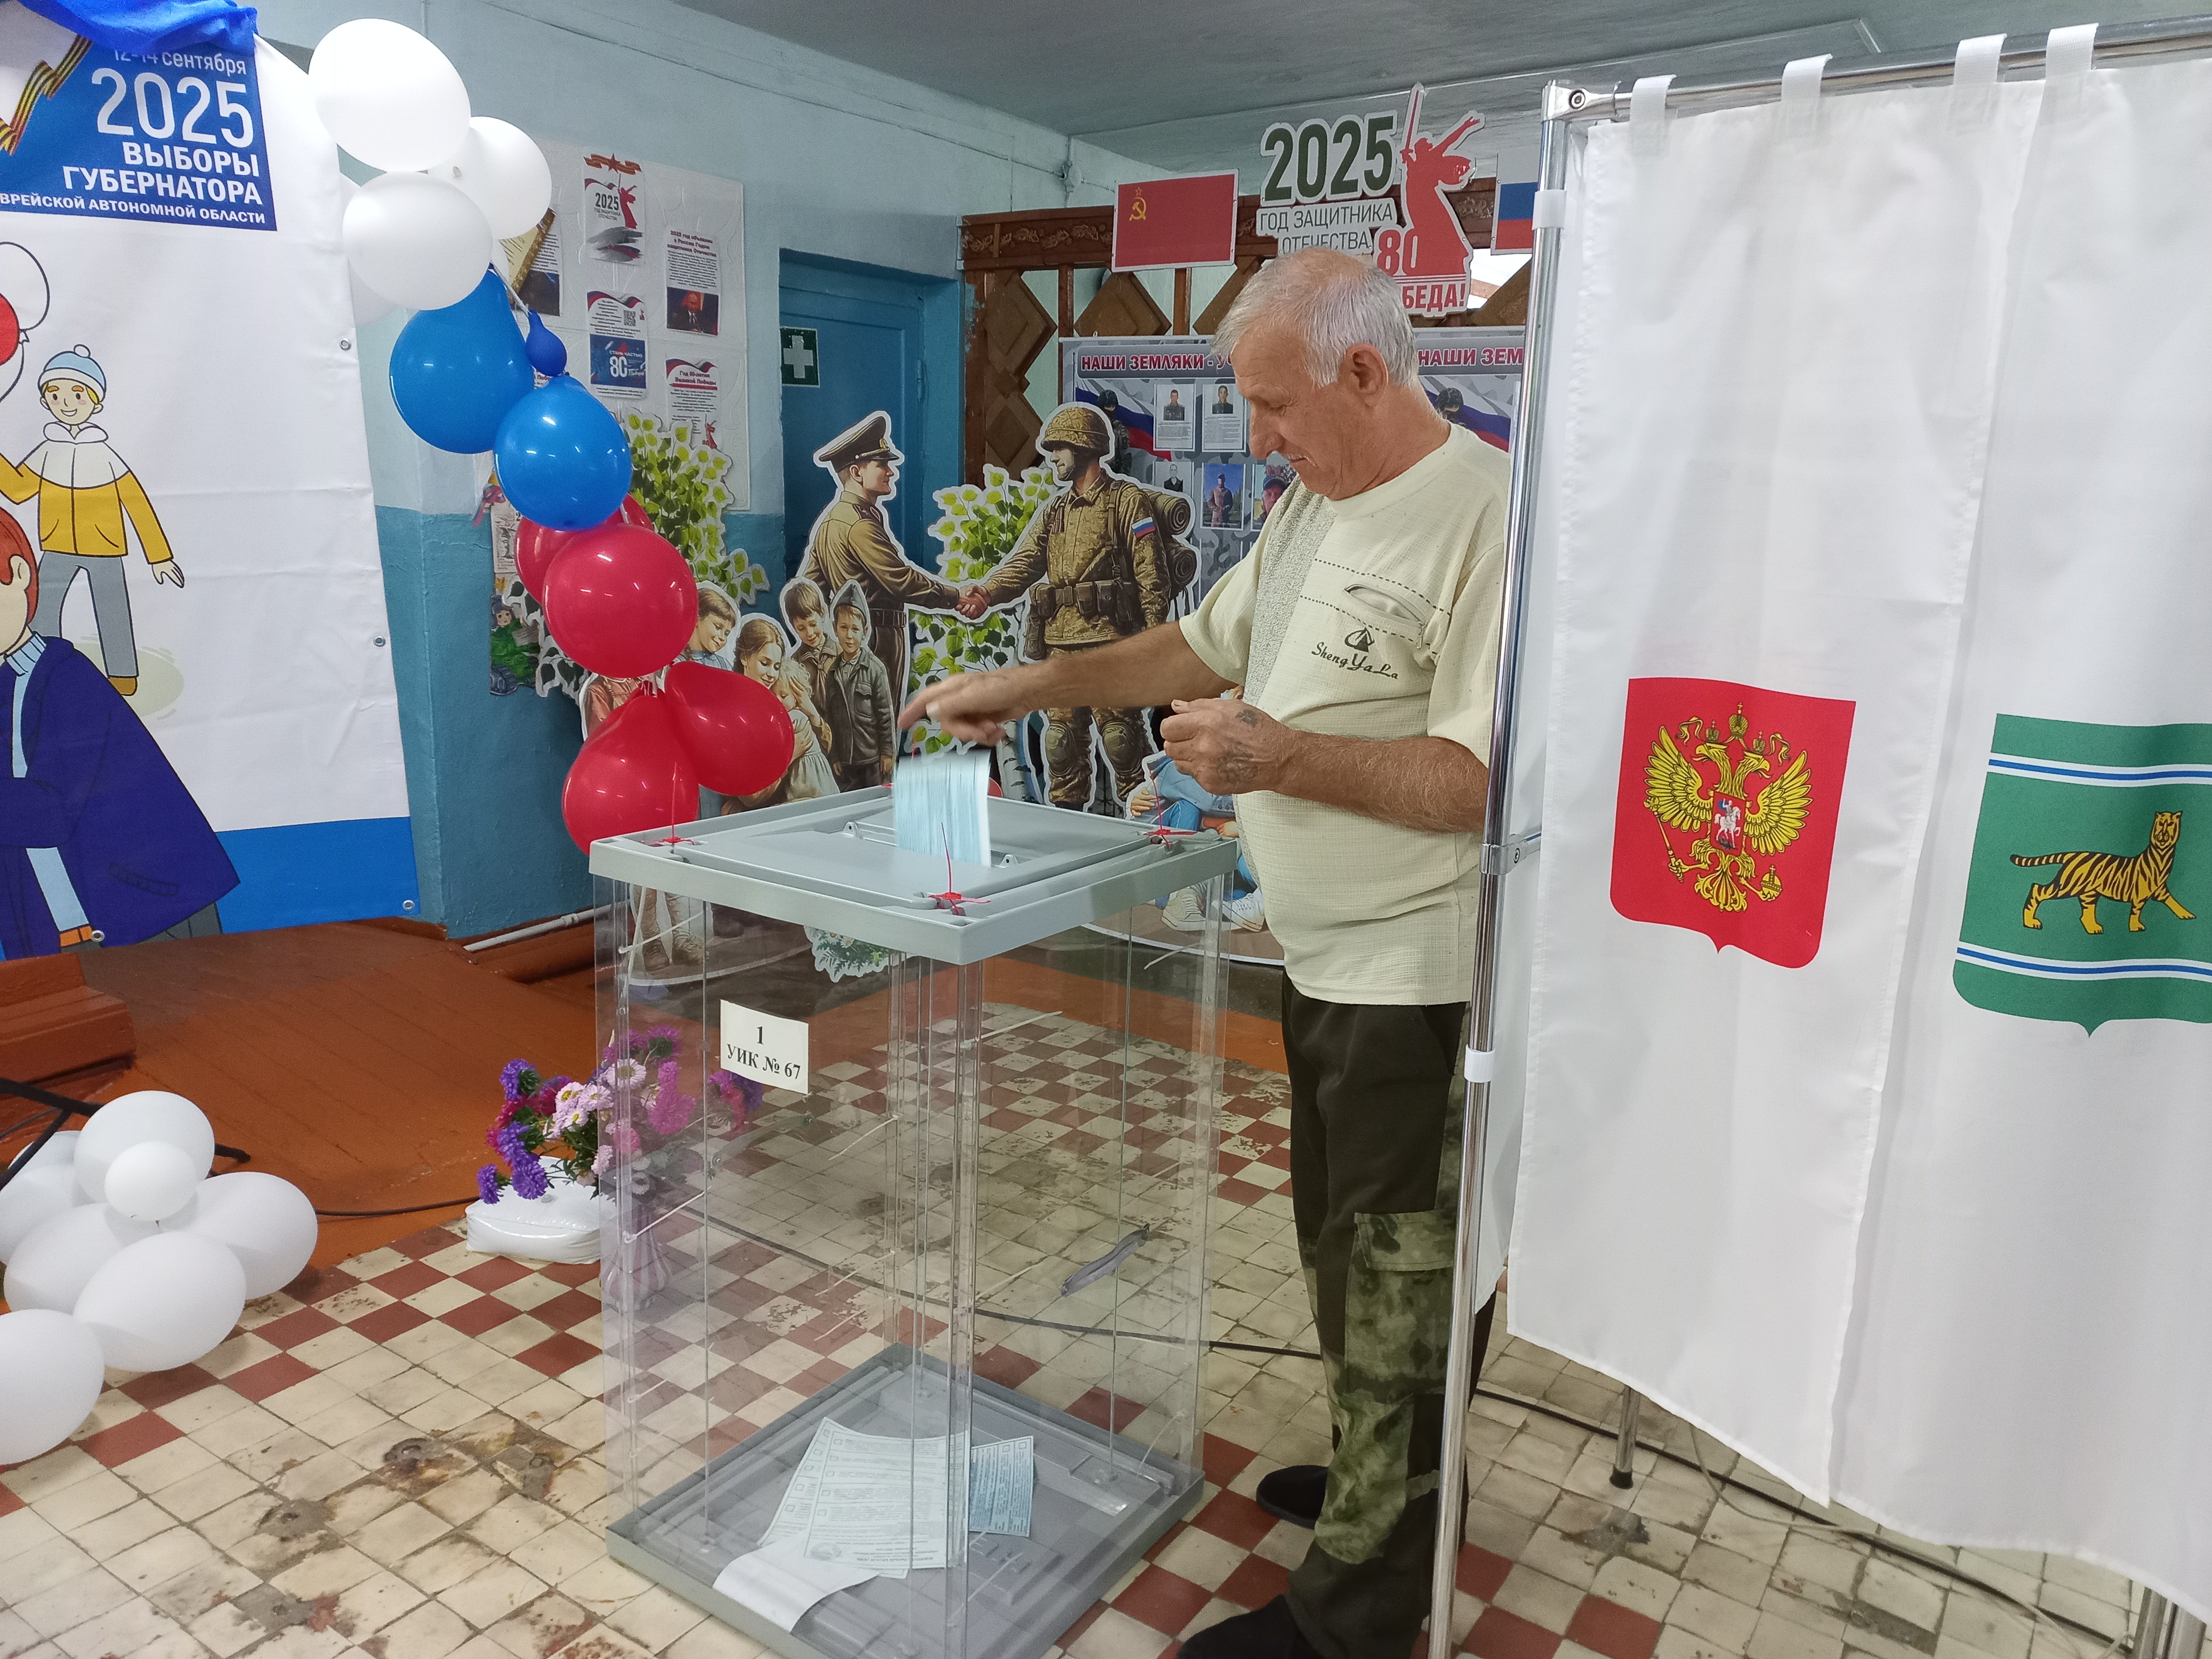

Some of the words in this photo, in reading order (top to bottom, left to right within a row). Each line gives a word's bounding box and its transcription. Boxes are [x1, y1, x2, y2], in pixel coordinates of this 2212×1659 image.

[161, 52, 247, 77] сентября
[91, 68, 254, 147] 2025
[122, 142, 259, 177] ВЫБОРЫ
[1264, 115, 1394, 201] 2025
[63, 166, 262, 205] ГУБЕРНАТОРА
[0, 192, 85, 209] ВРЕЙСКОЙ
[88, 199, 196, 219] АВТОНОМНОЙ
[199, 208, 265, 223] ОБЛАСТИ
[595, 192, 619, 210] 2025
[1261, 212, 1288, 232] ГОД
[1294, 203, 1393, 229] ЗАЩИТНИКА
[1377, 229, 1418, 276] 80
[1402, 283, 1465, 312] БЕДА!
[609, 356, 628, 377] 80
[1081, 355, 1126, 370] НАШИ
[1129, 354, 1204, 370] ЗЕМЛЯКИ
[1417, 348, 1477, 366] НАШИ
[1481, 347, 1524, 365] ЗЕМ
[757, 1026, 764, 1045] 1
[727, 1043, 759, 1069] УИК
[762, 1056, 780, 1074] №
[785, 1062, 801, 1080] 67
